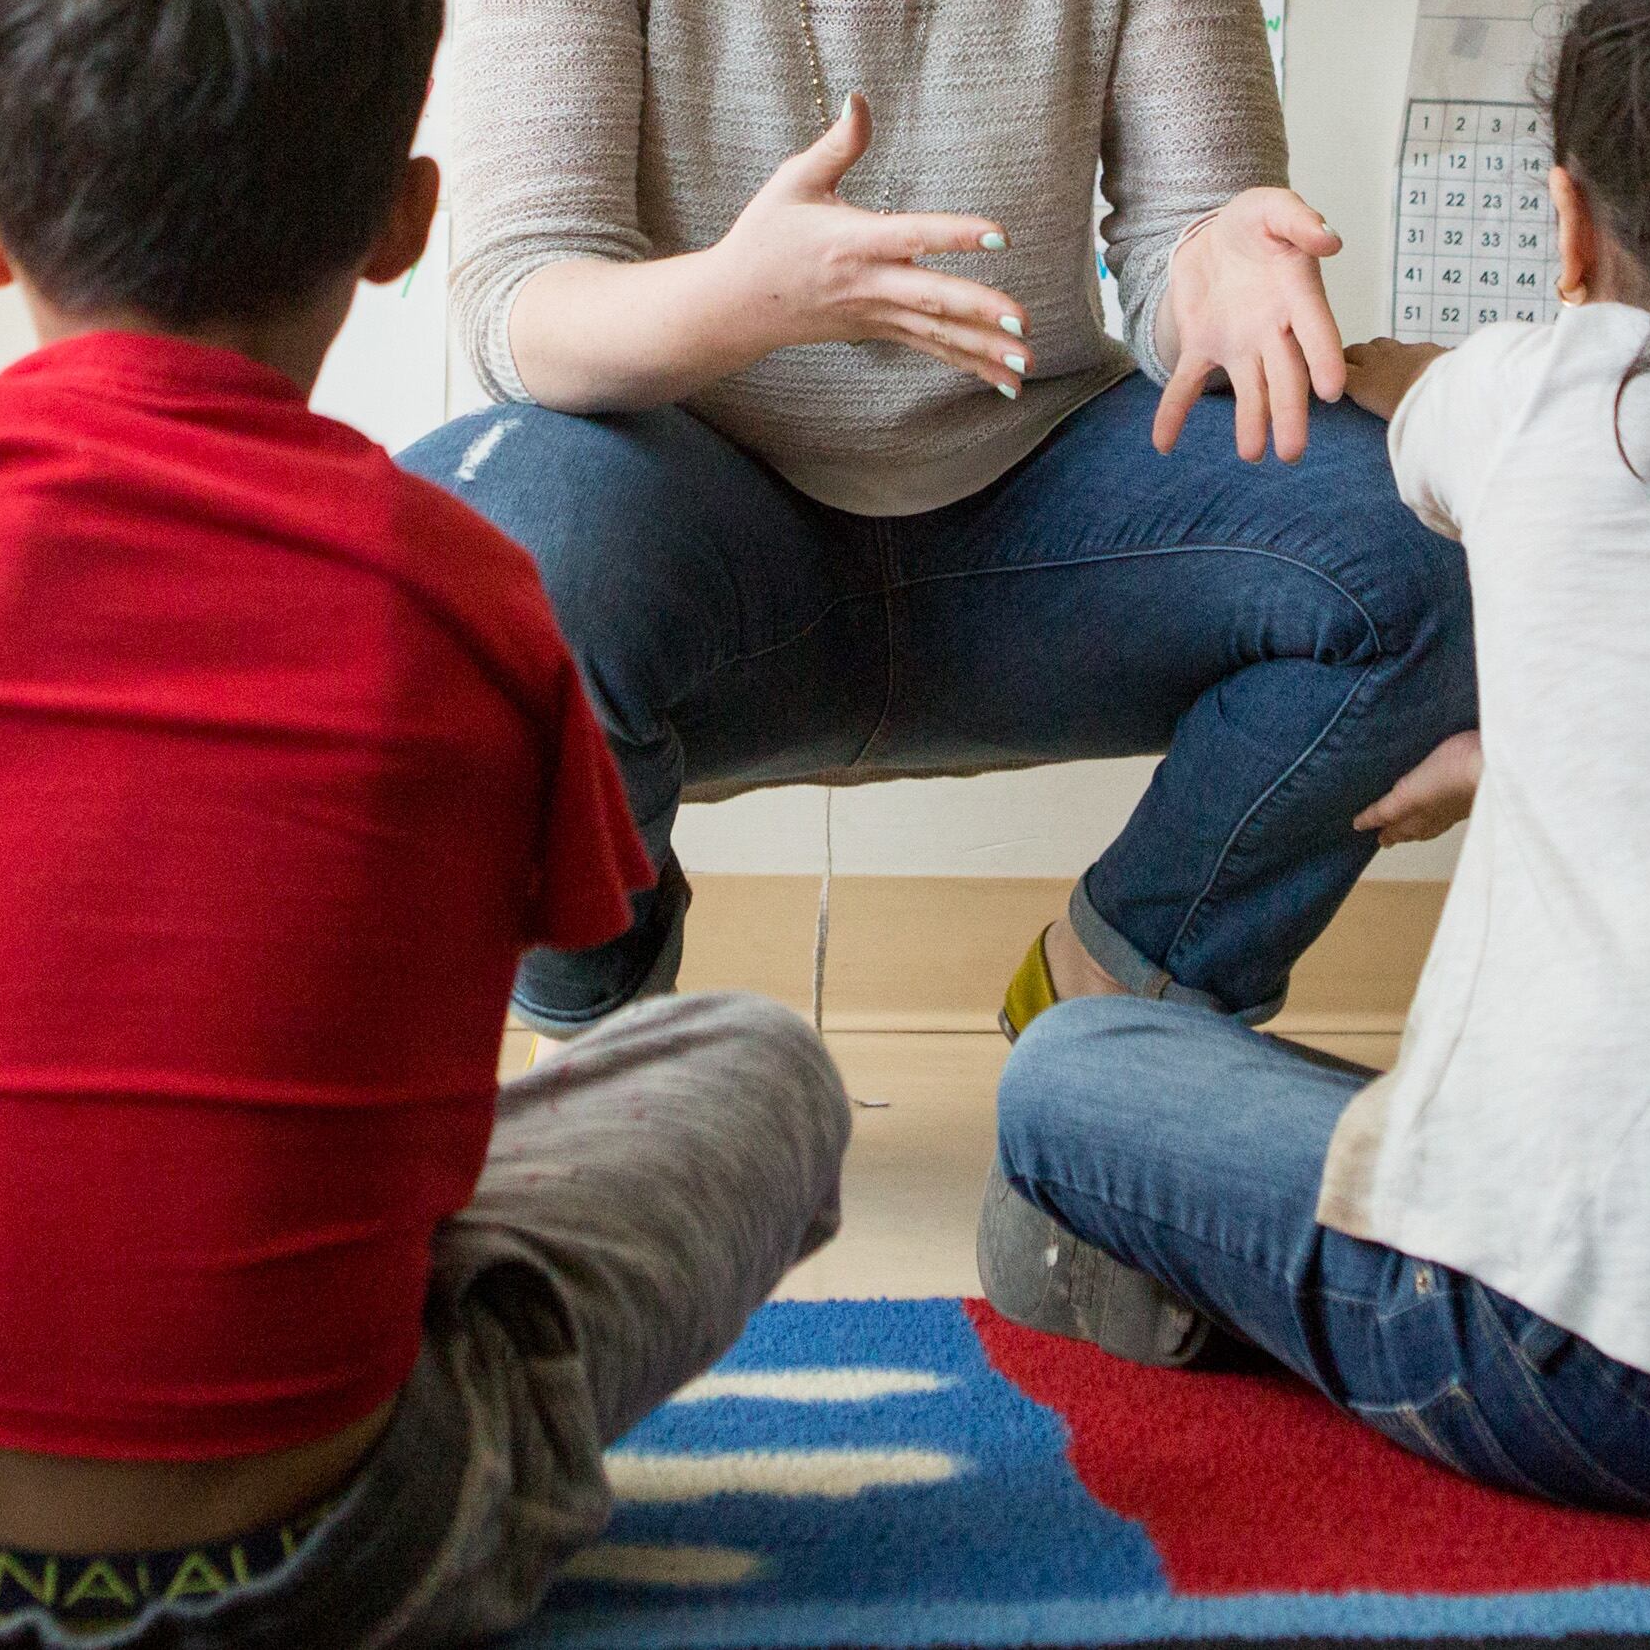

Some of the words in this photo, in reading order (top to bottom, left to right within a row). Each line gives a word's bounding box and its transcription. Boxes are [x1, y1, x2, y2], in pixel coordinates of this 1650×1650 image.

[1412, 152, 1430, 169] 11
[1448, 154, 1468, 171] 12
[1484, 155, 1505, 172] 13
[1408, 190, 1428, 206] 21
[1444, 191, 1466, 208] 22
[1481, 193, 1503, 210] 23
[1406, 227, 1426, 245] 31
[1443, 229, 1464, 247] 32
[1480, 230, 1502, 249] 33
